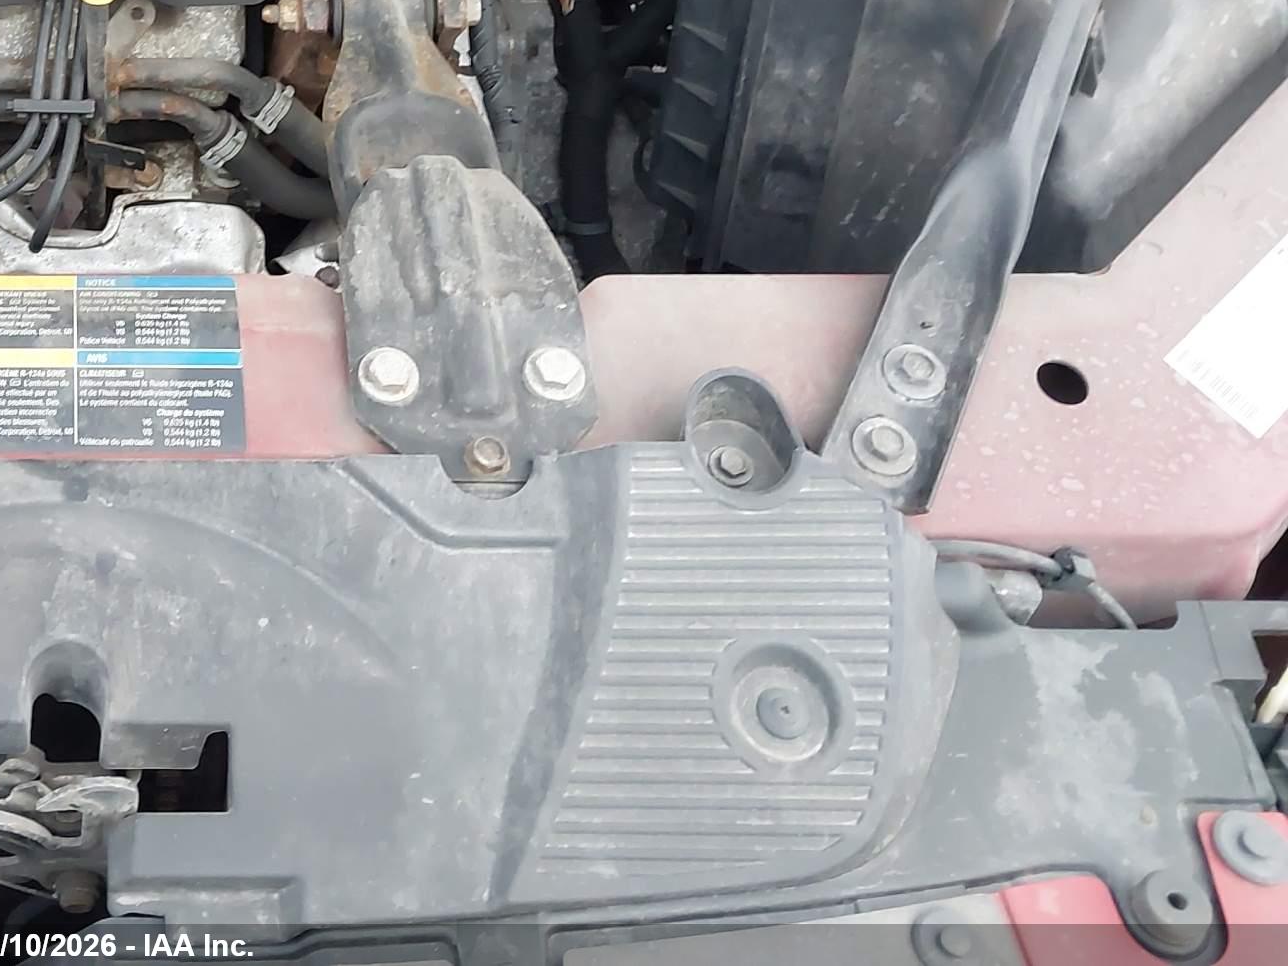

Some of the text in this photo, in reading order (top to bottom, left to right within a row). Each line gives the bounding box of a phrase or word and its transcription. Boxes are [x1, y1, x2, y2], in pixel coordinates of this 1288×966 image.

[85, 279, 116, 287] NOTICE
[156, 320, 165, 328] kg
[156, 328, 165, 336] kg
[156, 337, 166, 346] kg
[166, 337, 180, 346] (1.2
[86, 353, 108, 363] AVIS
[208, 379, 234, 388] R-134a
[34, 389, 47, 397] par
[48, 389, 58, 397] un
[46, 398, 60, 406] Des
[80, 399, 88, 407] Le
[156, 408, 183, 417] Charge
[185, 418, 194, 427] kg
[195, 418, 209, 427] (1.4
[185, 428, 195, 437] kg
[196, 428, 210, 437] (1.2
[185, 438, 195, 447] kg
[196, 438, 210, 447] (1.2
